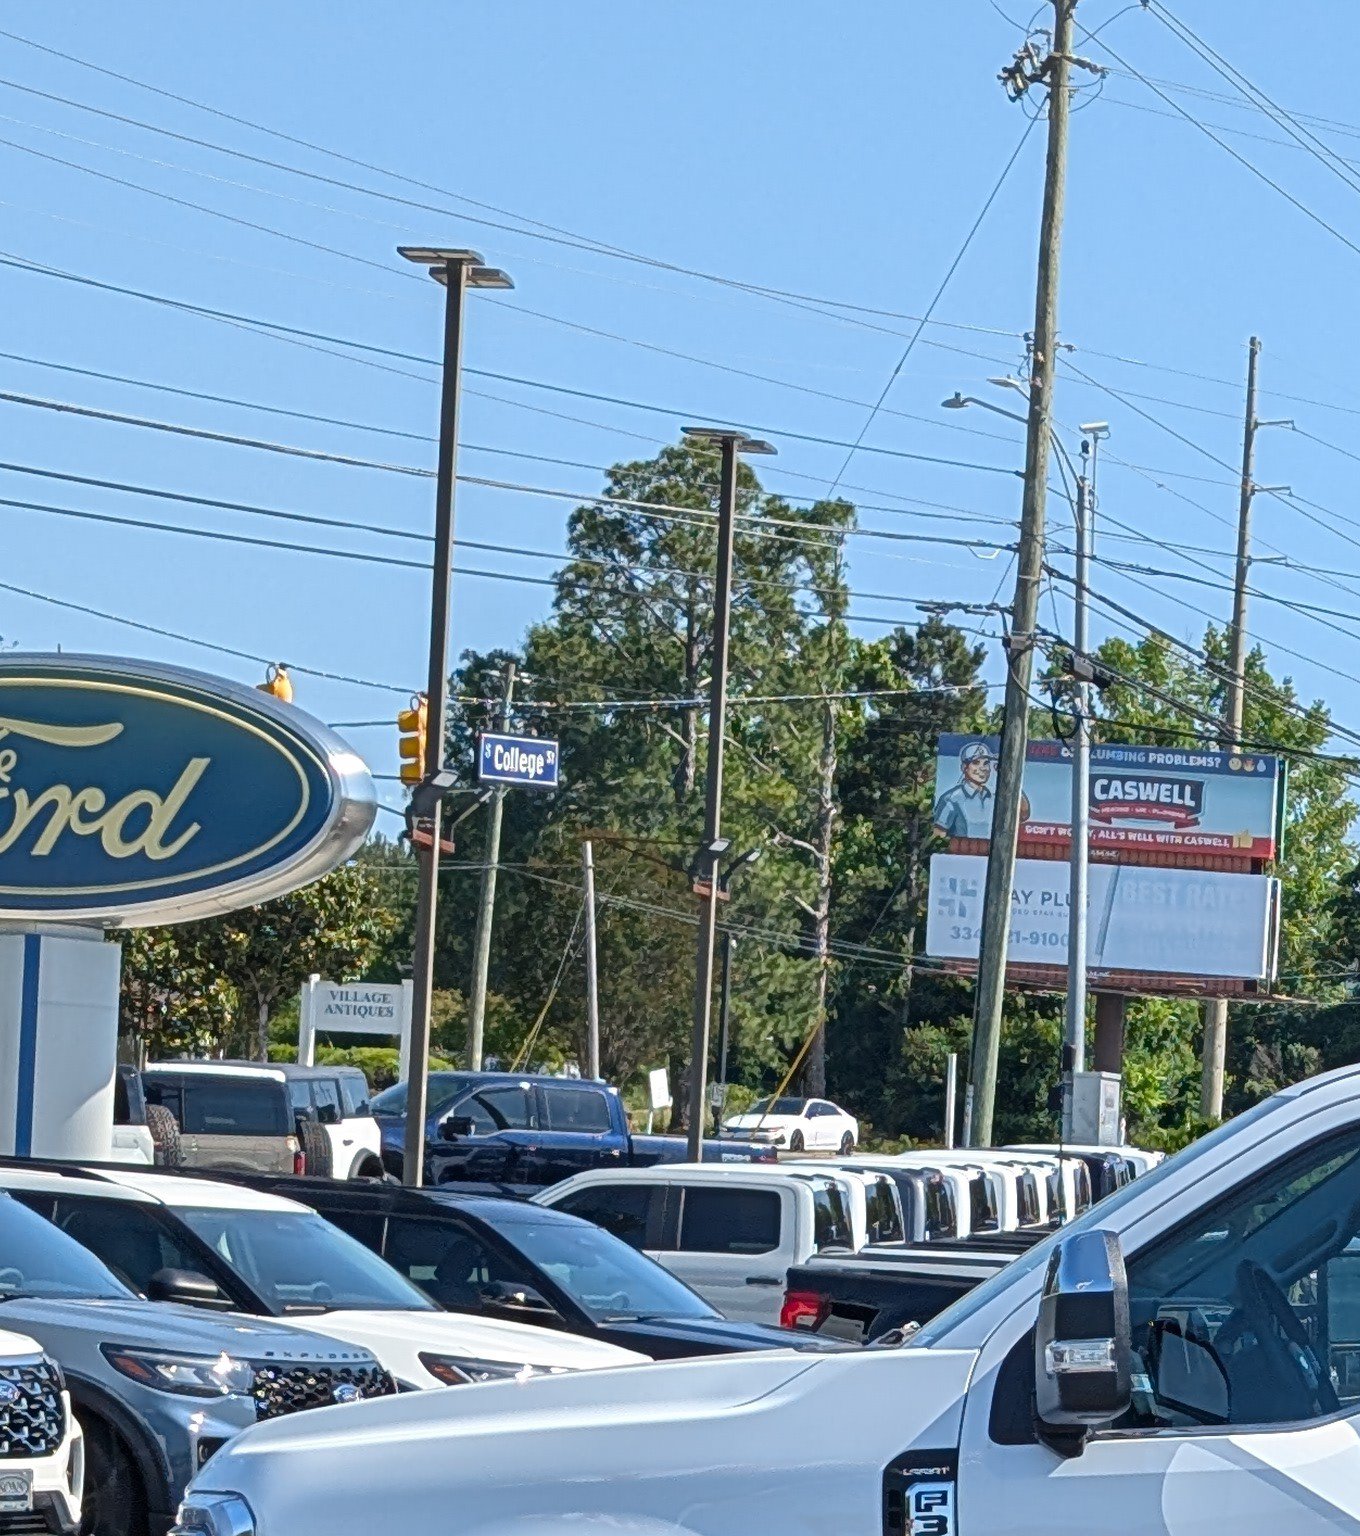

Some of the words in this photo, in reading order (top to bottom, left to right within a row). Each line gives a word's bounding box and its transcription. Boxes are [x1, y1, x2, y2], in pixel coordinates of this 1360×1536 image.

[494, 744, 544, 778] College
[1090, 749, 1146, 763] LUMBING
[1148, 752, 1222, 768] PROBLEMS?
[1093, 778, 1196, 807] CASWELL
[1156, 834, 1182, 845] WITH
[1041, 891, 1091, 908] PL
[330, 990, 392, 1004] VILLAGE
[325, 1003, 395, 1019] ANTIQUES
